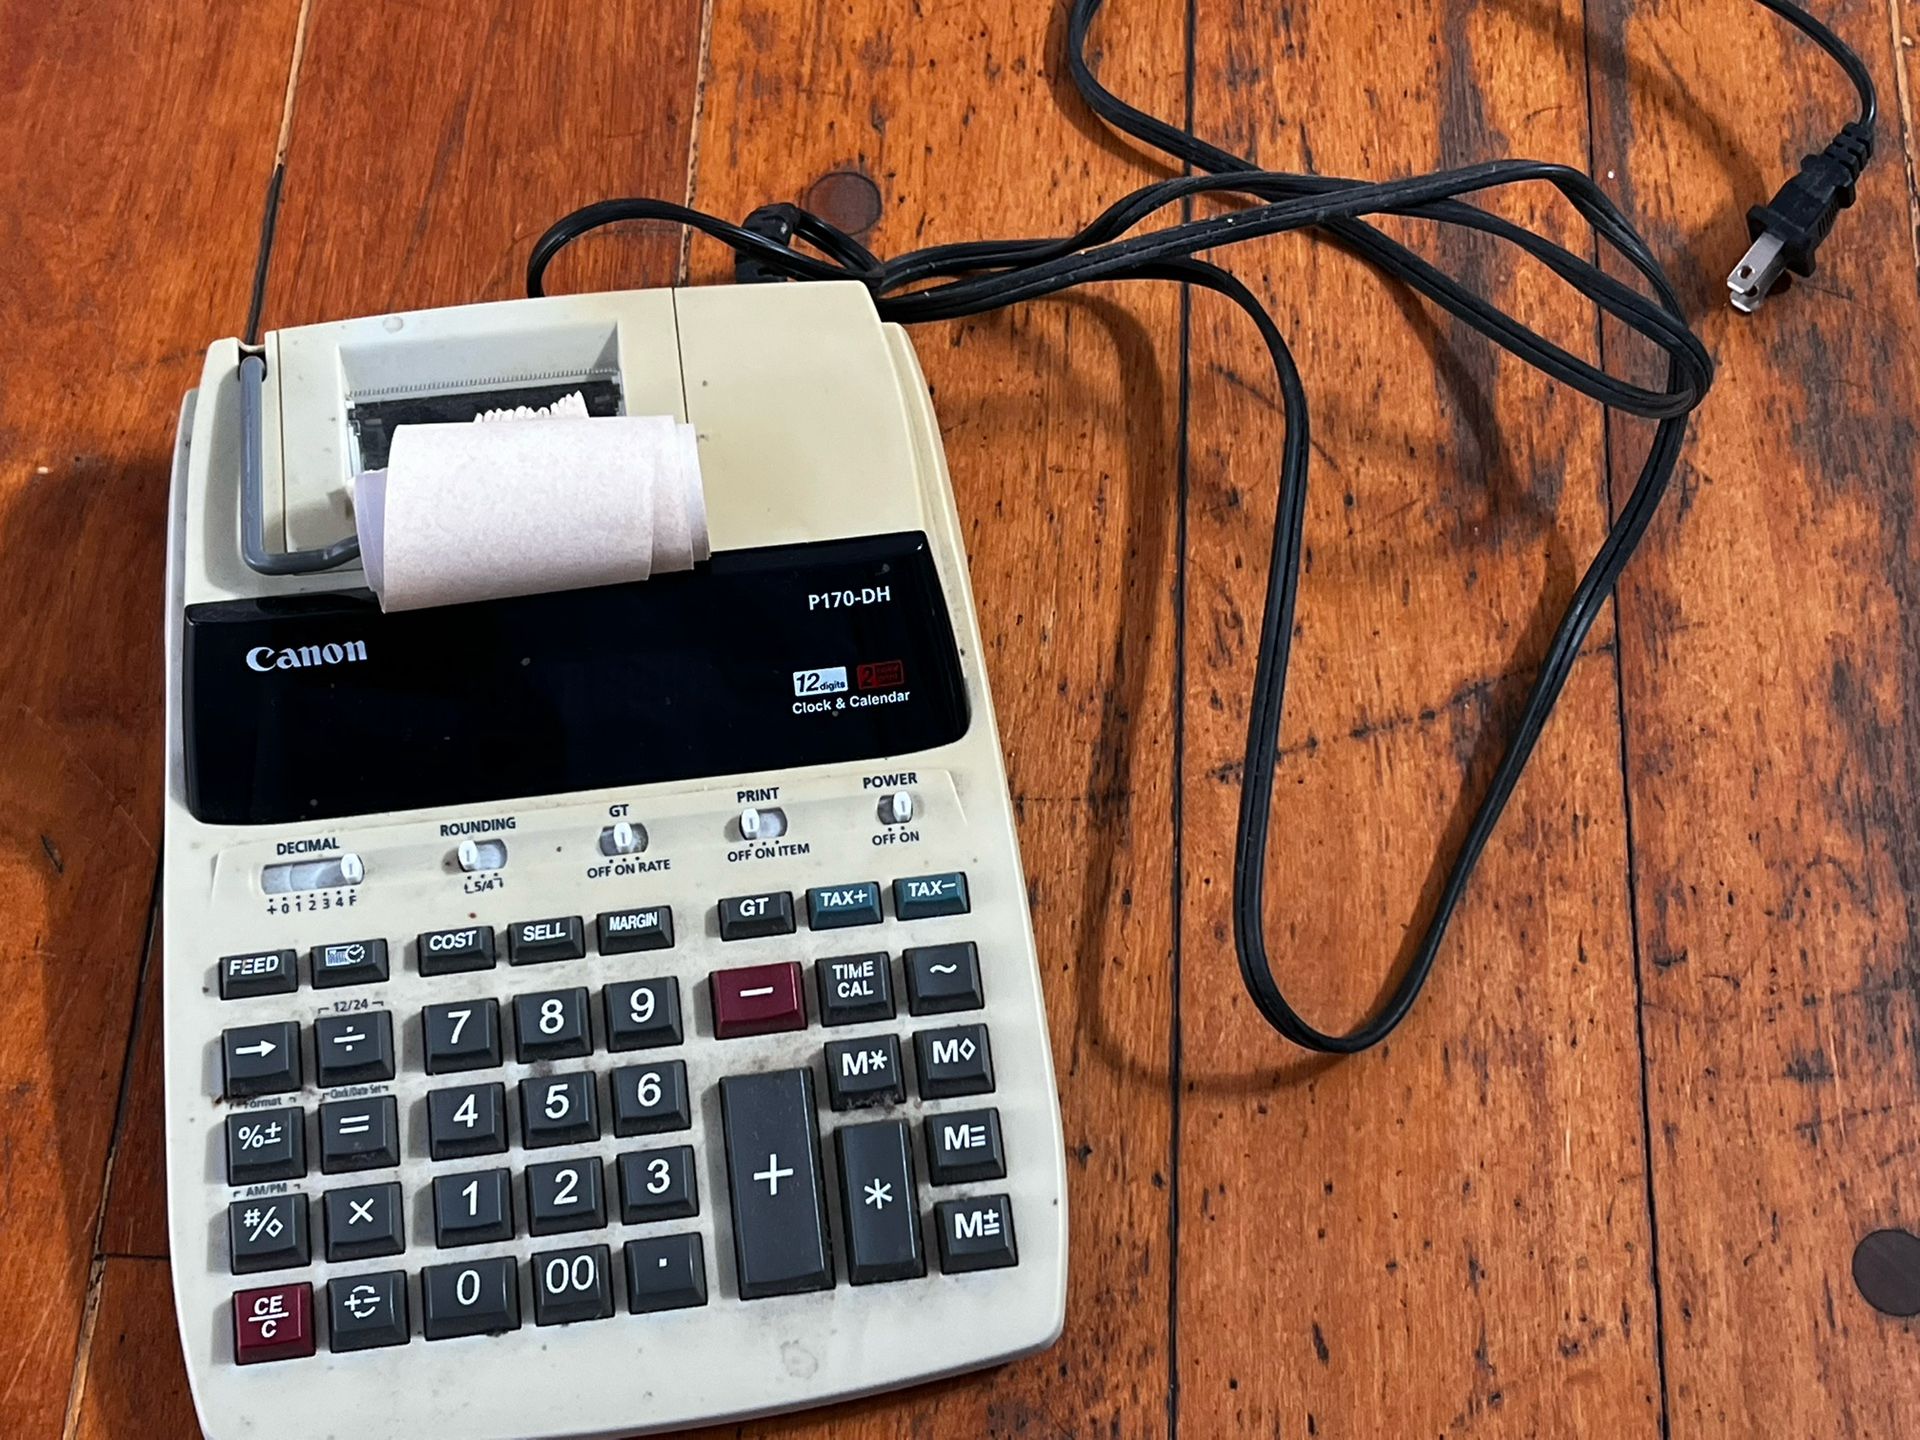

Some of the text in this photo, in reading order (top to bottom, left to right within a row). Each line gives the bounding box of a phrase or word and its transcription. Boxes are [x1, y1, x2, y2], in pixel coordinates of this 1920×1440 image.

[808, 586, 891, 610] P170-DH
[246, 640, 368, 671] Canon
[796, 672, 846, 693] 12 digits
[792, 690, 910, 714] Clock & Calendar
[863, 772, 917, 789] POWER
[737, 787, 780, 803] PRINT
[609, 804, 629, 818] GT
[440, 817, 516, 837] ROUNDING
[276, 837, 340, 856] DECIMAL
[872, 831, 920, 846] OFF ON
[727, 842, 811, 863] OFF ON ITEM
[587, 859, 671, 879] OFF ON RATE
[282, 903, 290, 914] 0
[295, 902, 302, 912] 1
[309, 900, 317, 911] 2
[322, 899, 331, 909] 3
[335, 897, 344, 907] 4
[349, 895, 358, 906] F
[740, 897, 769, 916] GT
[820, 889, 868, 907] TAX+
[523, 922, 567, 942] SELL
[609, 912, 658, 931] MARGIN
[429, 931, 477, 951] COST
[229, 955, 279, 976] FEED
[832, 960, 874, 980] TIME
[837, 981, 874, 998] CAL
[333, 999, 368, 1012] 12/24
[630, 987, 655, 1023] 9
[447, 1010, 472, 1044] 7
[539, 999, 565, 1035] 8
[637, 1072, 662, 1107] 6
[453, 1094, 479, 1128] 4
[544, 1084, 570, 1119] 5
[646, 1158, 671, 1194] 3
[753, 1153, 794, 1196] +
[246, 1182, 287, 1197] AM/PM
[553, 1169, 579, 1205] 2
[461, 1180, 478, 1216] 1
[545, 1255, 595, 1294] 00
[456, 1270, 480, 1305] 0
[254, 1295, 283, 1316] CE
[261, 1320, 277, 1338] C
